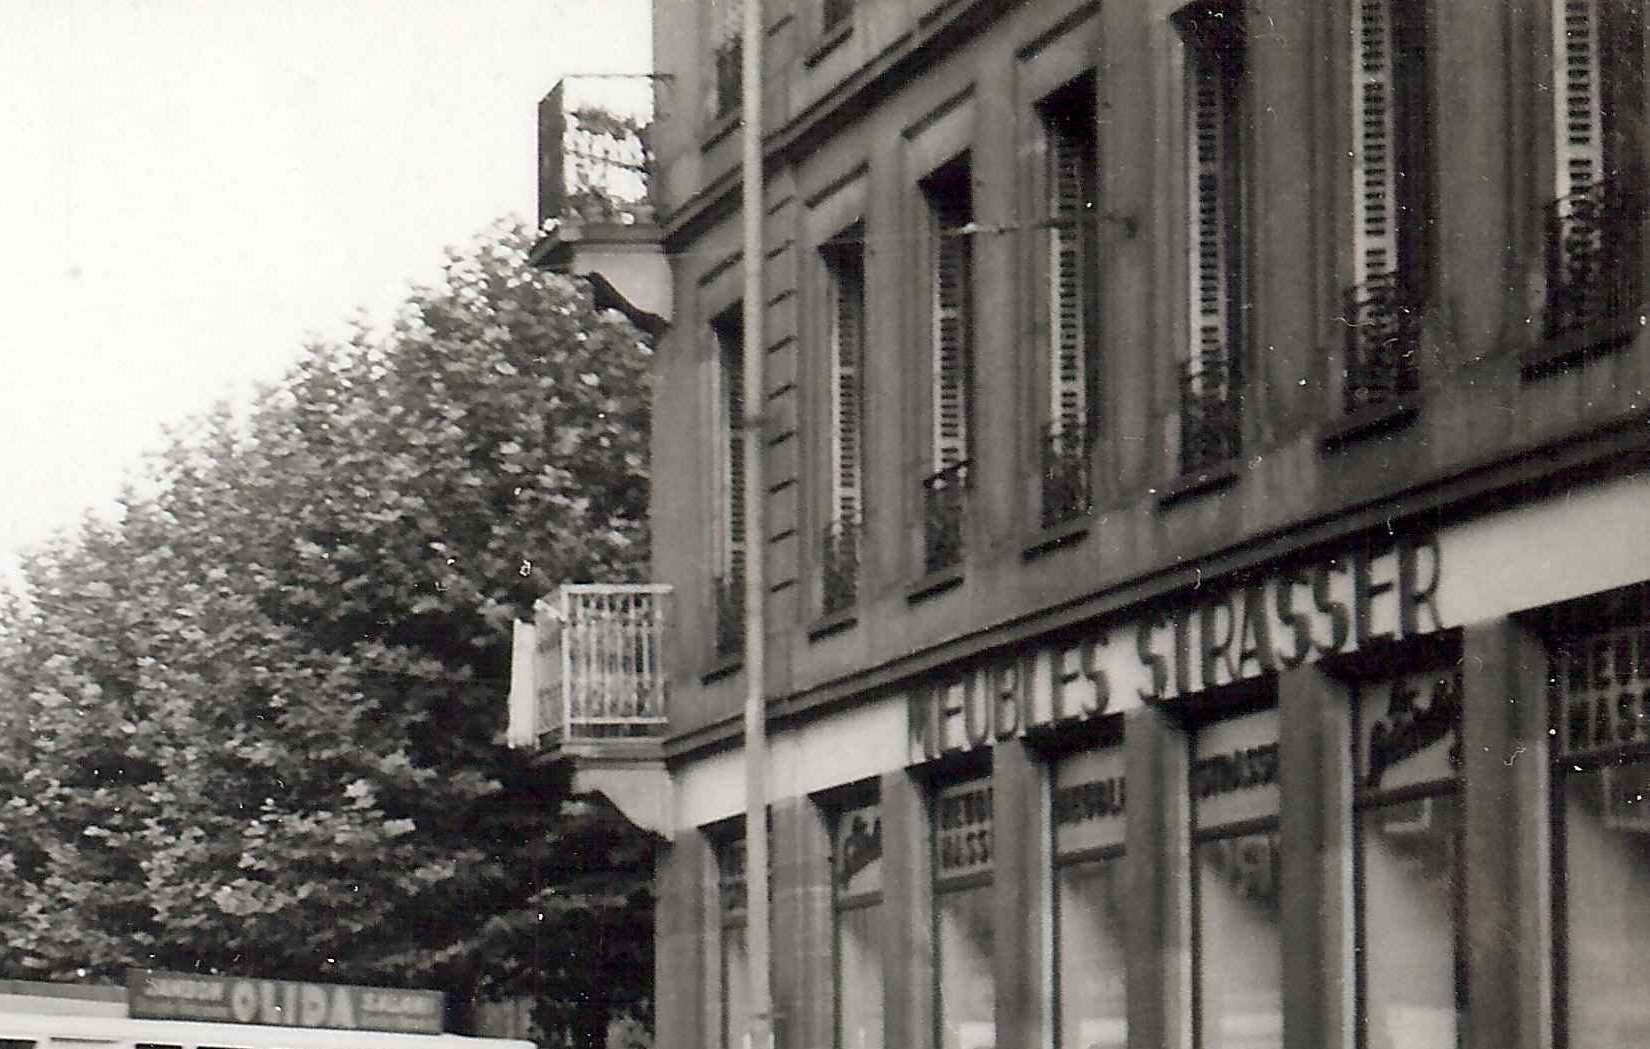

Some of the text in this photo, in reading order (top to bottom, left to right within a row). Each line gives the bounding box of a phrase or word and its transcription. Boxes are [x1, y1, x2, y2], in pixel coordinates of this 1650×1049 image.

[908, 537, 1444, 760] MEUBLES STRASSER
[231, 979, 357, 1029] OLIDA
